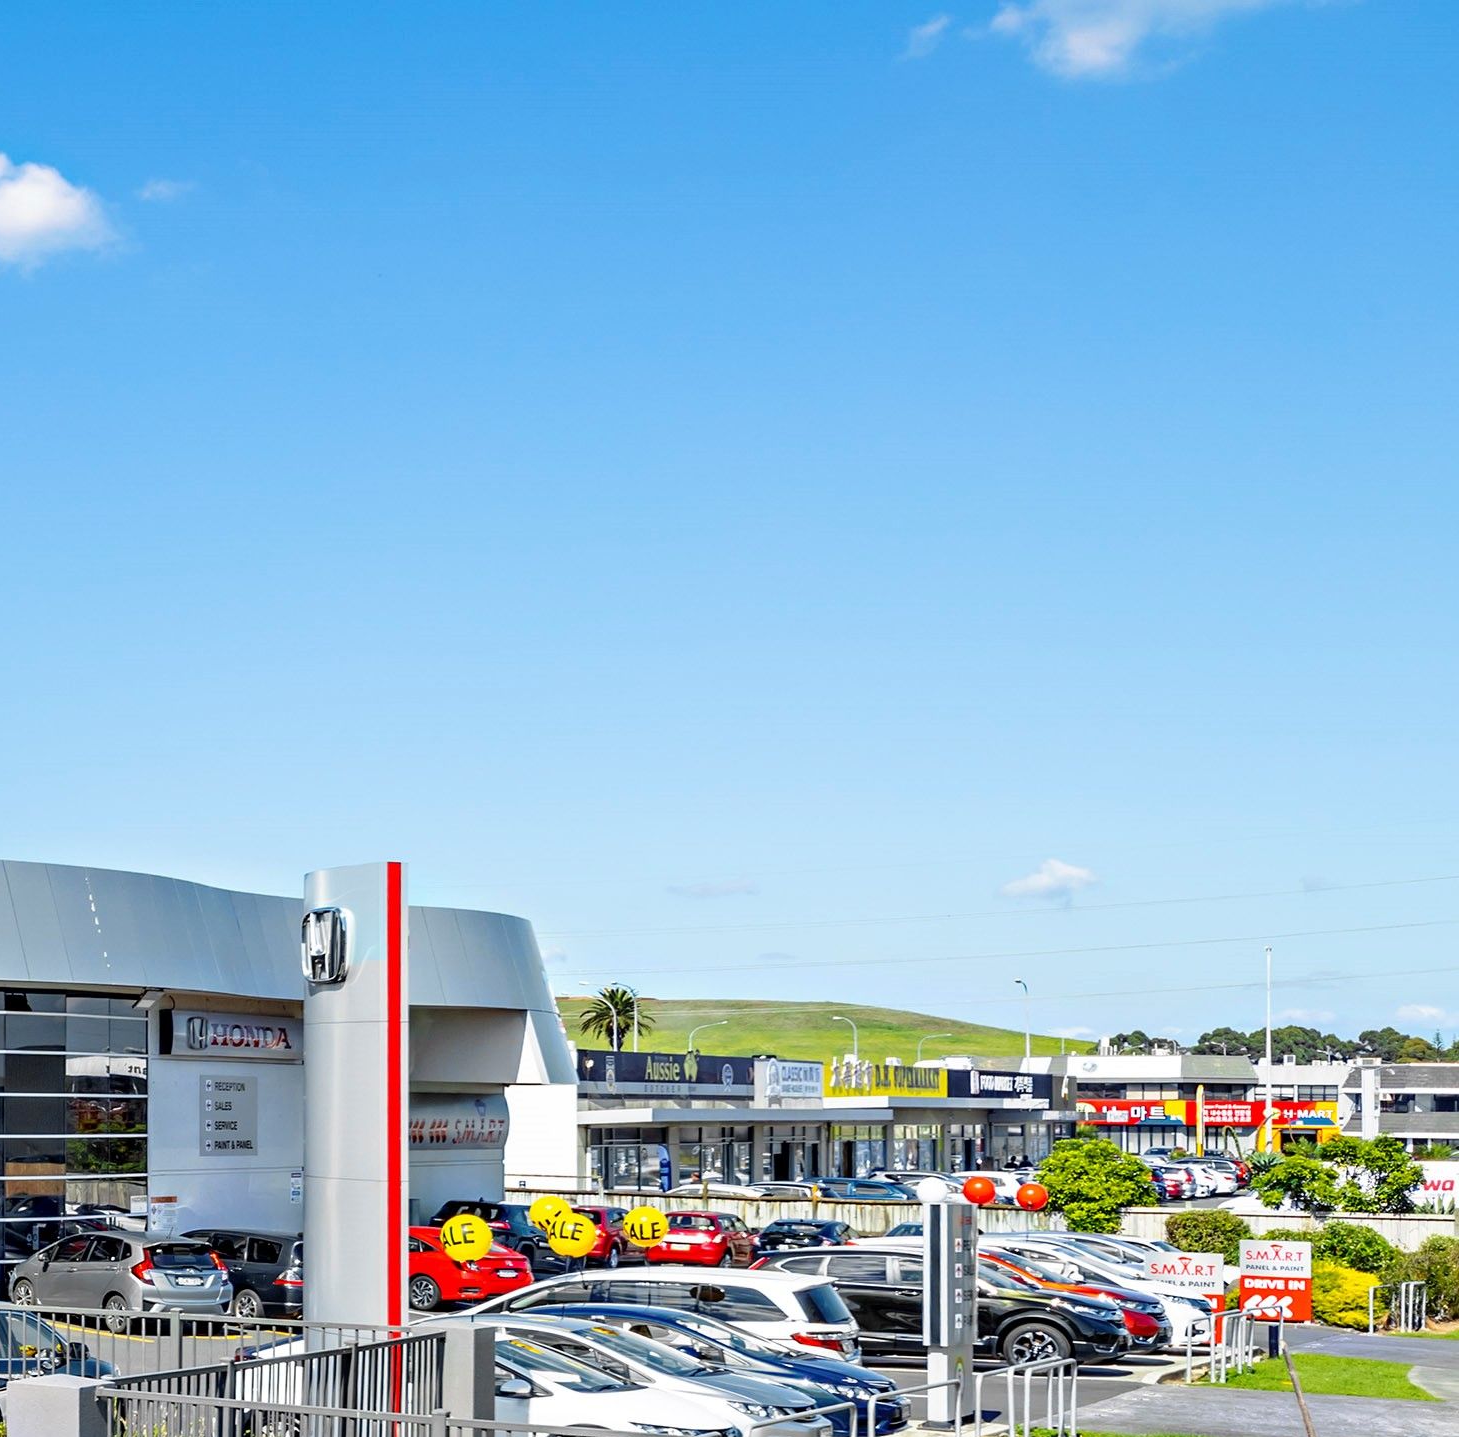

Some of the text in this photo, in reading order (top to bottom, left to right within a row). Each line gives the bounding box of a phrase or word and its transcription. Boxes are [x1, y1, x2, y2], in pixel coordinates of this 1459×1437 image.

[210, 1023, 292, 1050] HONDA
[644, 1055, 681, 1082] Aussie
[214, 1082, 246, 1092] RECEPTION
[214, 1101, 232, 1111] SALES
[214, 1121, 238, 1131] SERVICE
[214, 1140, 230, 1150] PAINT
[236, 1141, 254, 1150] PANEL
[442, 1222, 476, 1249] ALE
[546, 1220, 584, 1242] ALE
[1244, 1278, 1306, 1291] DRIVE IN
